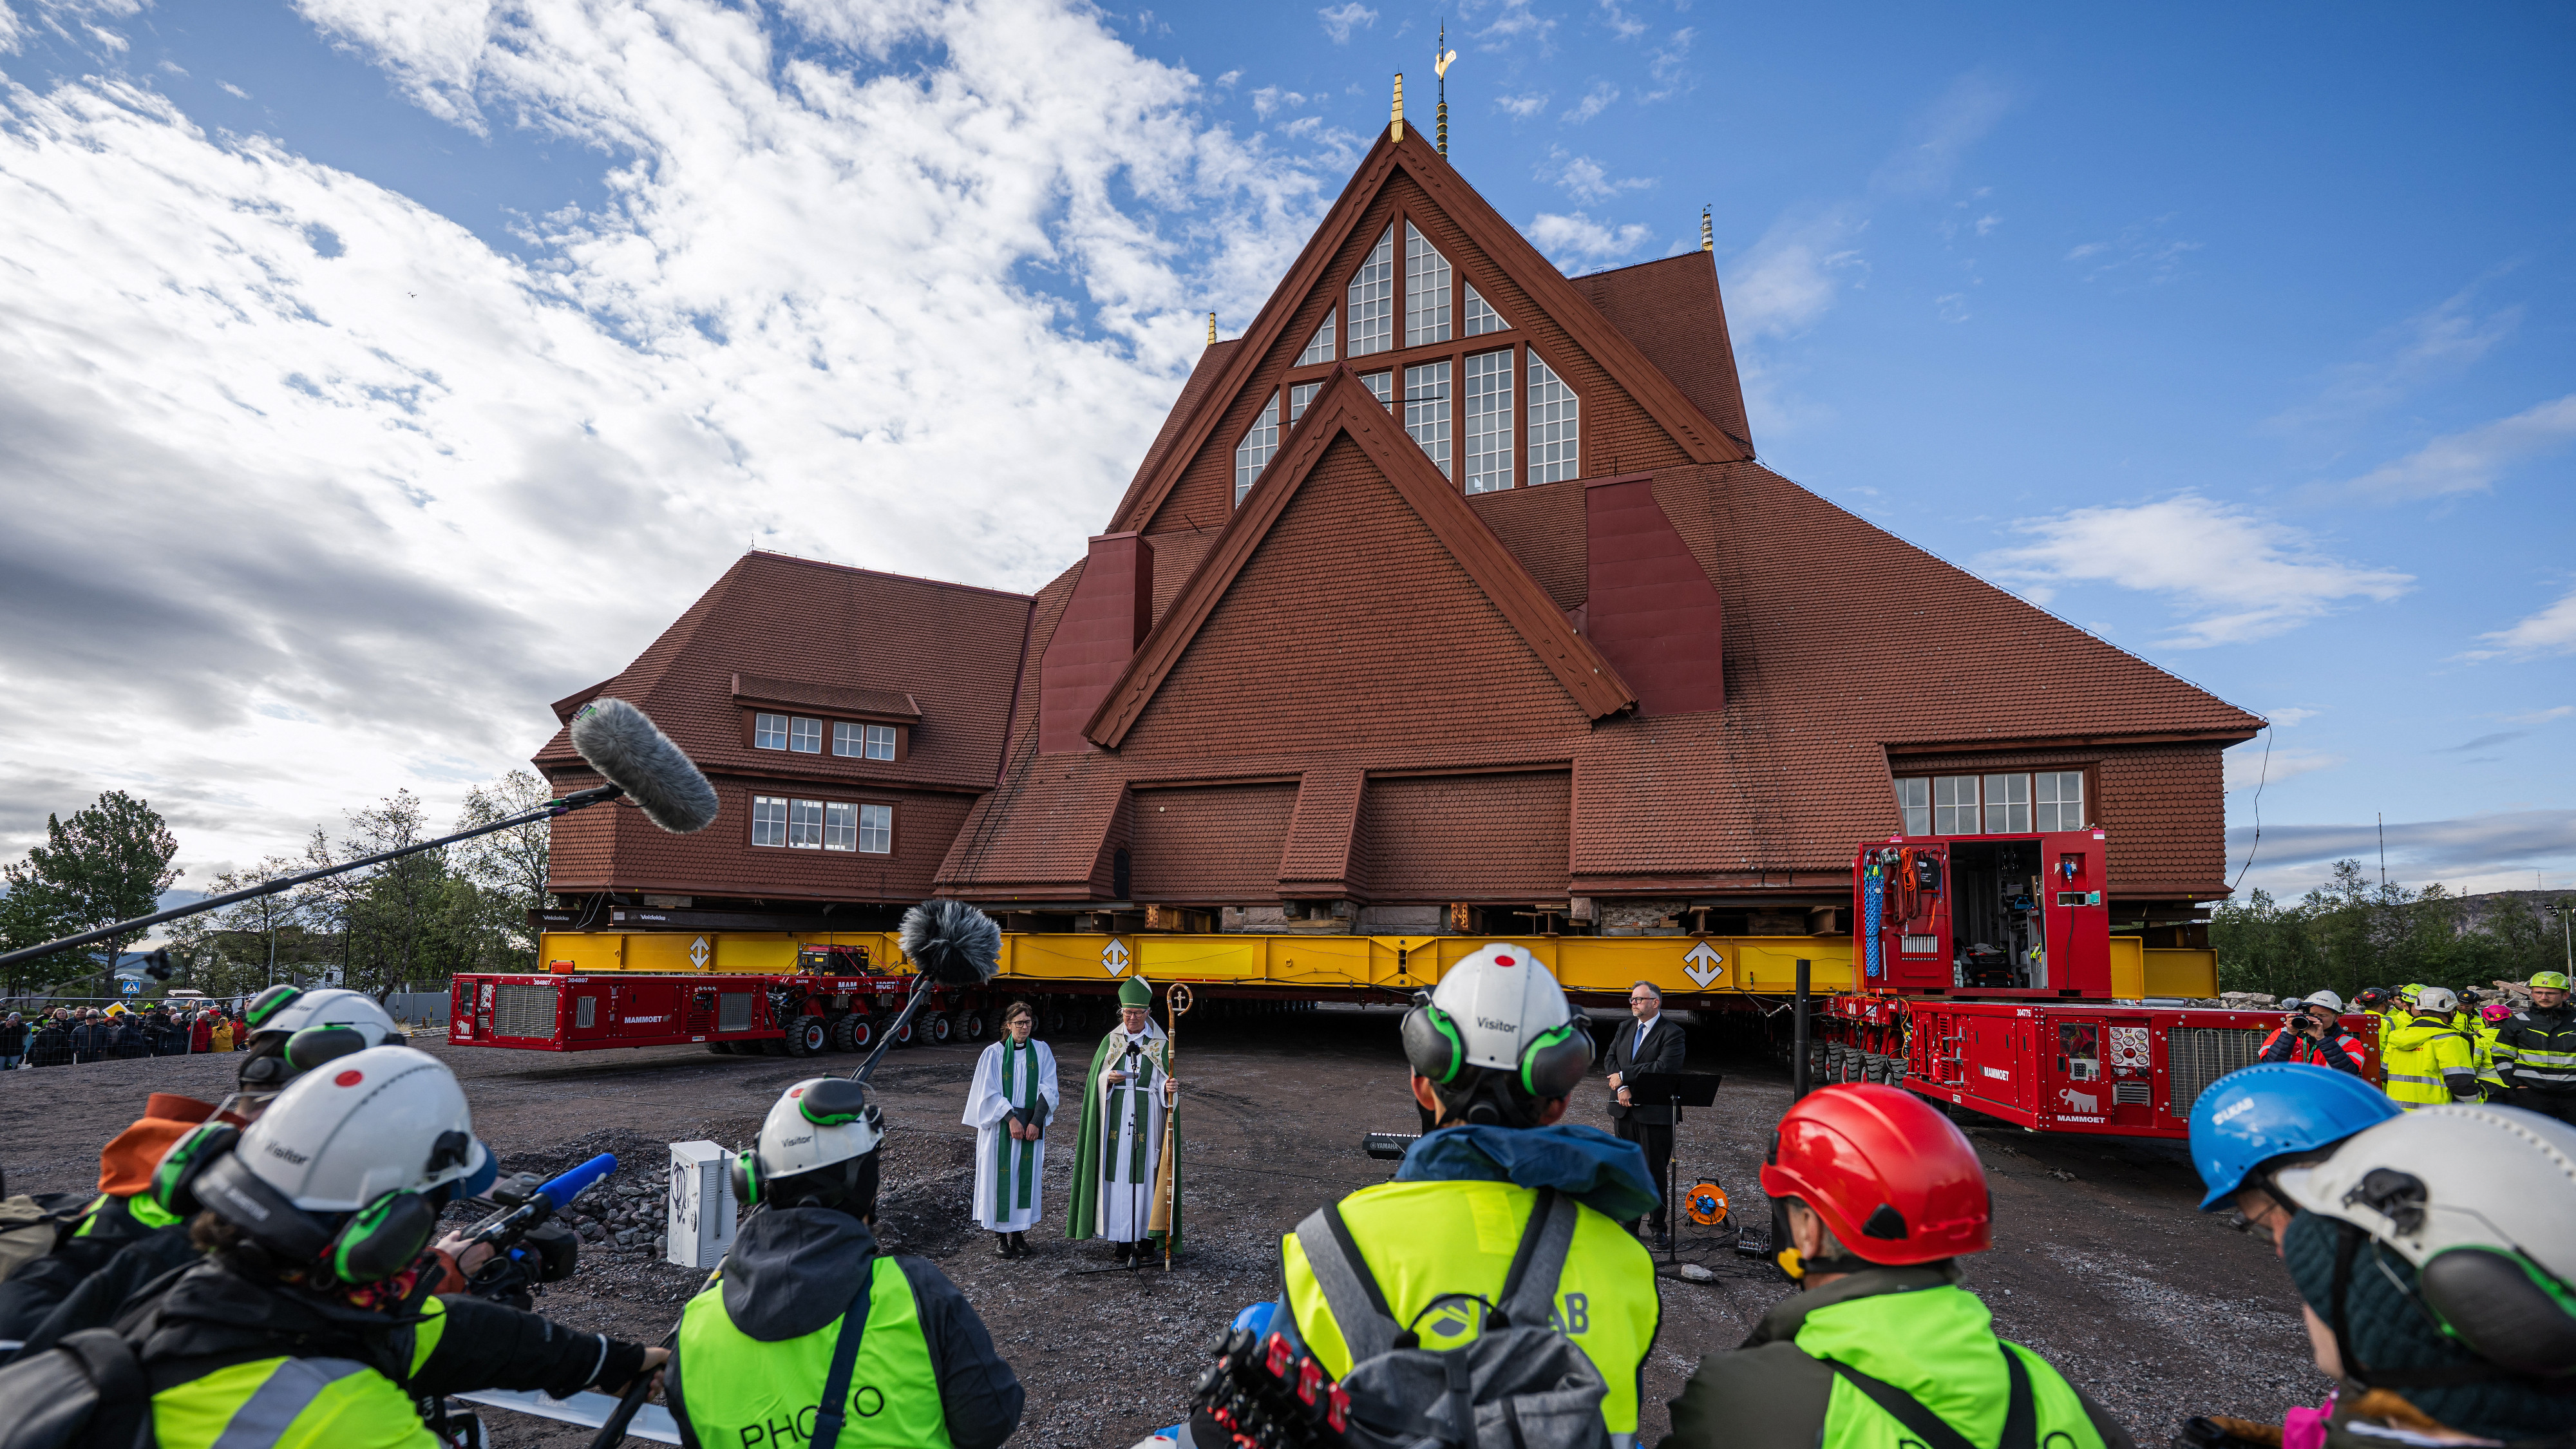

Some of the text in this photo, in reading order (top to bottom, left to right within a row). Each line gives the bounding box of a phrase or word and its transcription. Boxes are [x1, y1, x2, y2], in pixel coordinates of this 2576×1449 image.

[838, 981, 895, 990] MAM MOET
[2016, 1009, 2031, 1017] 304775
[1477, 1017, 1518, 1033] Visitor
[1984, 1066, 2009, 1081] MAMMOET
[2057, 1115, 2105, 1123] MAMMOET
[781, 1135, 813, 1148] Visitor
[739, 1386, 885, 1449] PHOO
